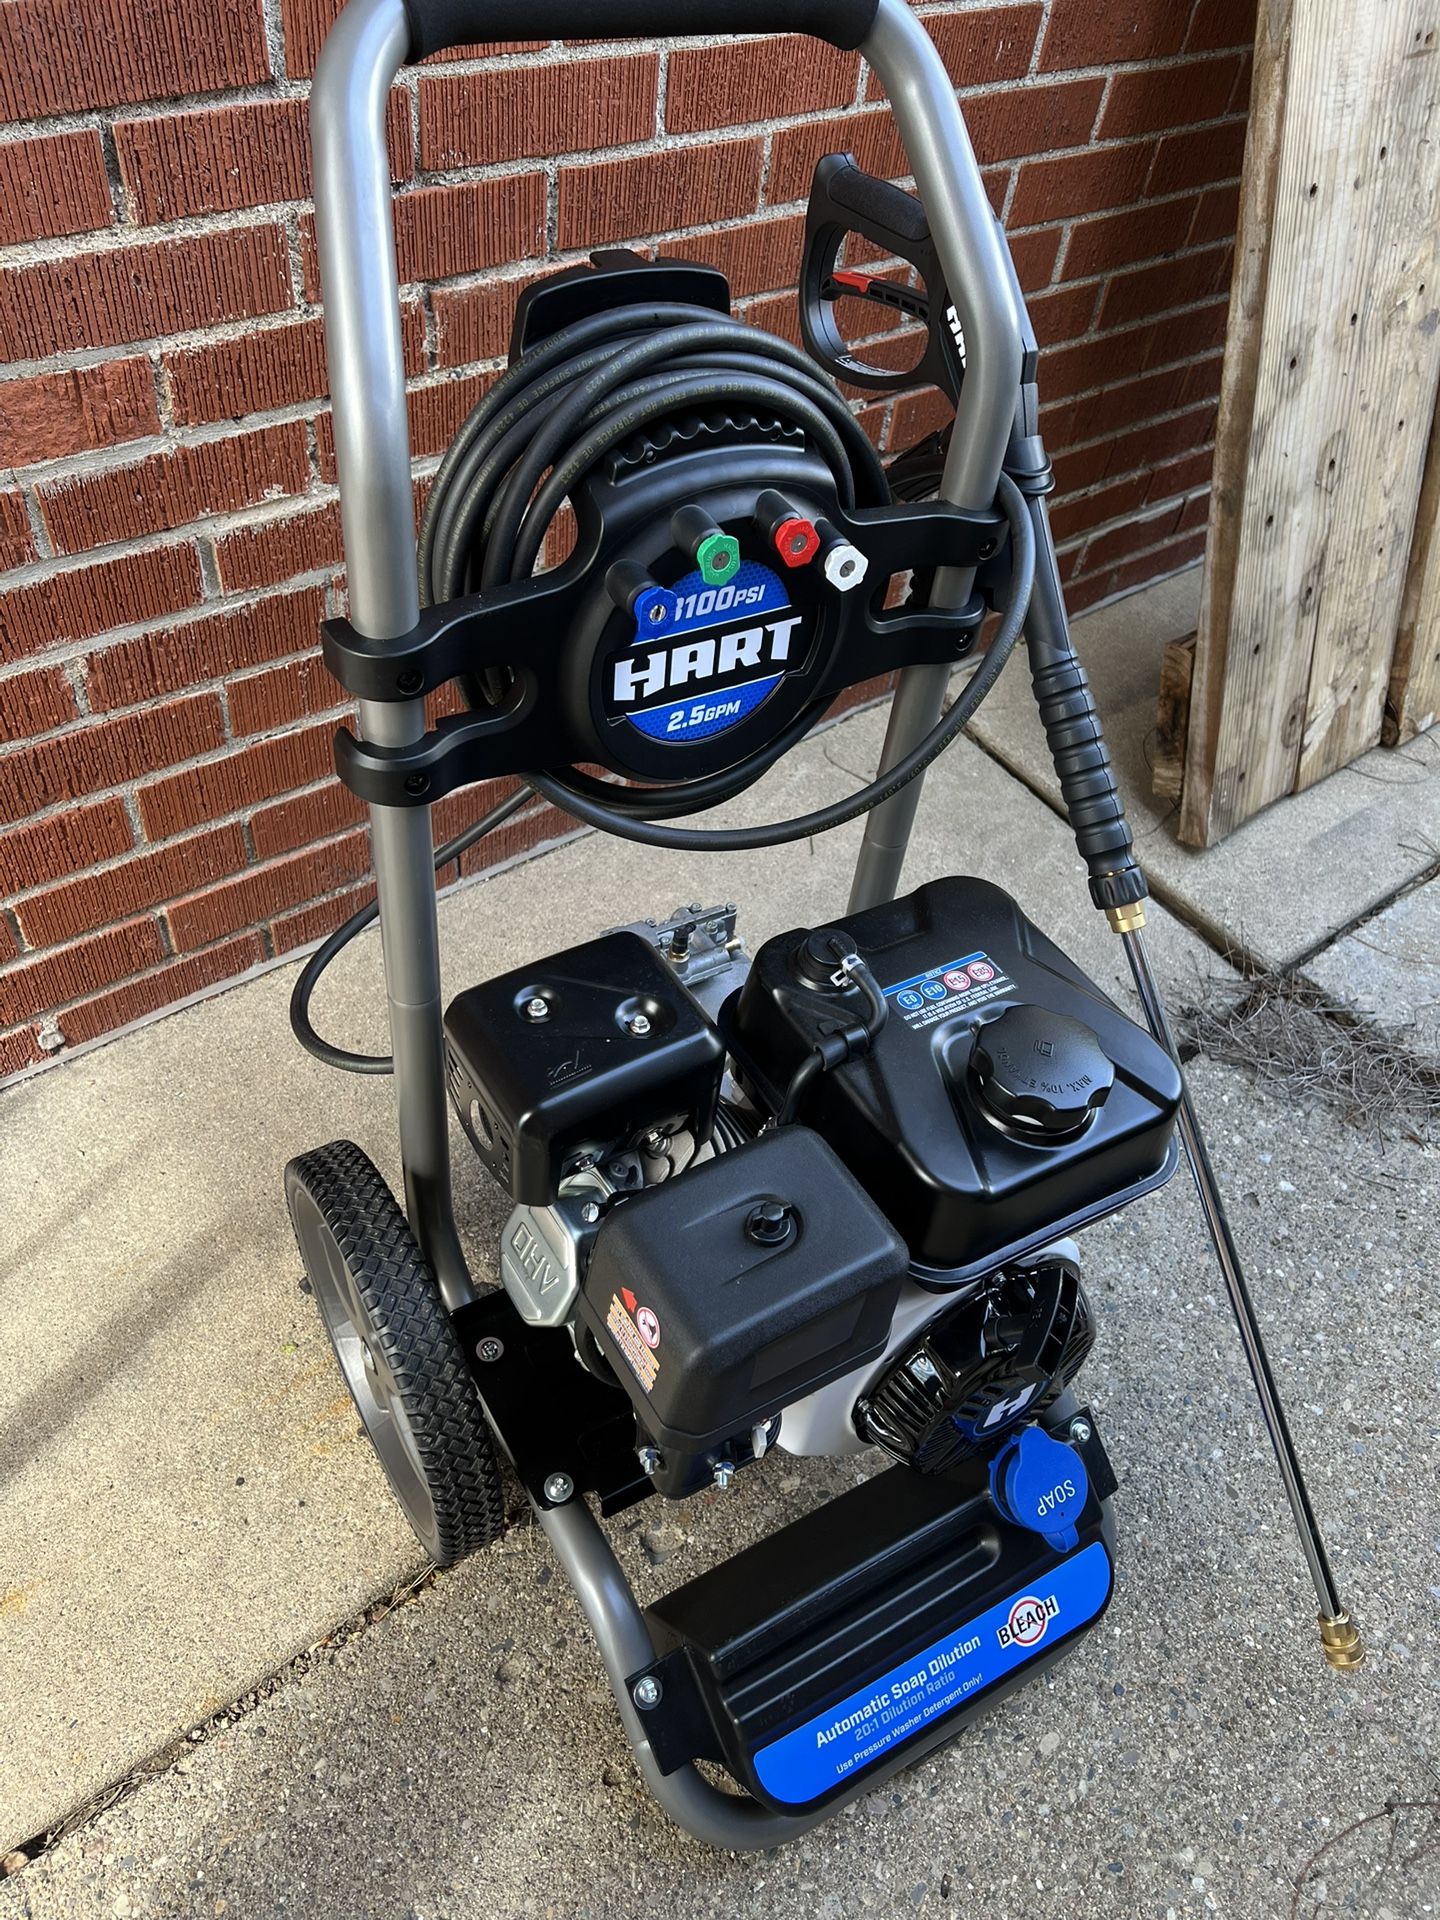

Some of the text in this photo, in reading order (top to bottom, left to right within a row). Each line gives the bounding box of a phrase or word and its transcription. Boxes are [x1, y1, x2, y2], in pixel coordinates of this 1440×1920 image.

[574, 356, 594, 372] HOT
[621, 337, 664, 364] SURFACE
[530, 367, 572, 399] SURFACE
[661, 390, 687, 405] FROM
[720, 381, 744, 392] KEEP
[637, 400, 658, 416] HOT
[594, 411, 636, 446] SURFACE
[614, 616, 802, 701] HART
[667, 700, 741, 733] 2.5GPM
[903, 995, 918, 1005] E0
[924, 984, 942, 996] E10
[511, 1222, 559, 1295] OHV
[1037, 1479, 1075, 1516] SOAP
[998, 1598, 1056, 1646] BLEACH
[816, 1636, 981, 1748] Automatic Soap Dilution
[854, 1671, 956, 1741] 20:1 Dilution Ratio
[836, 1673, 983, 1774] Use Pressure Washer Detergent Only!
